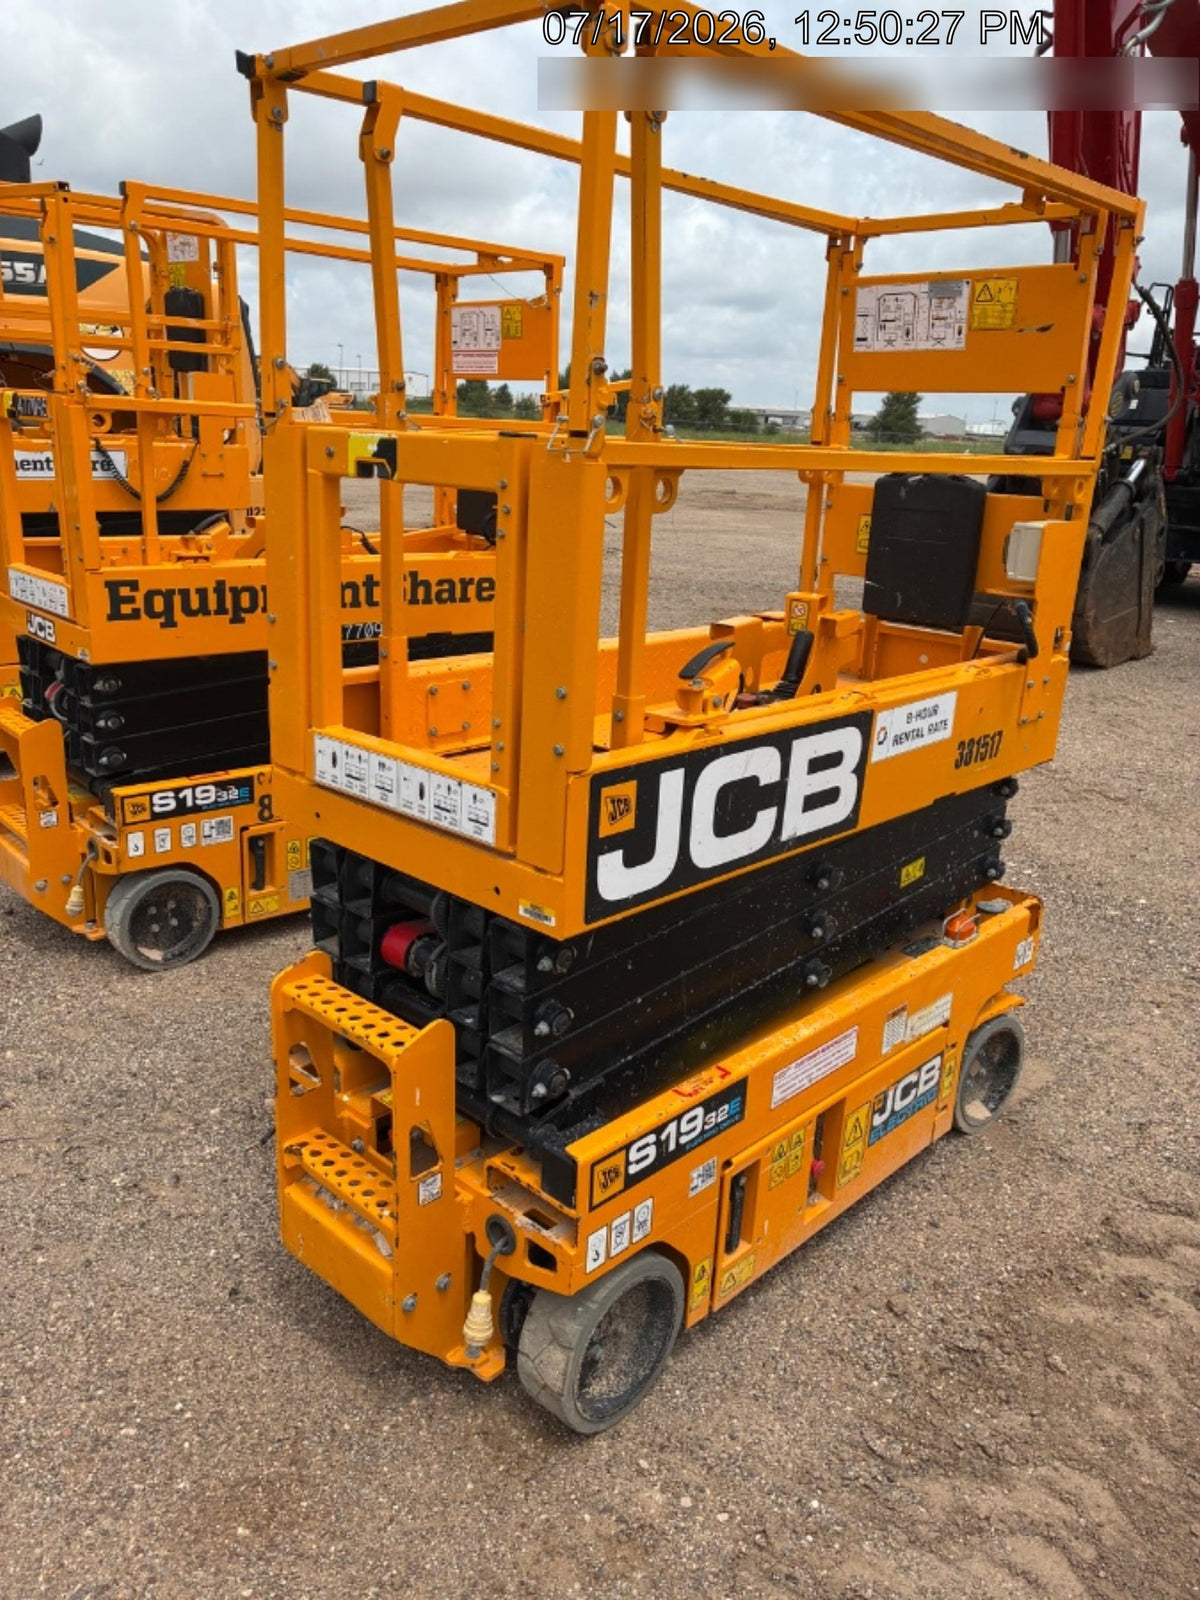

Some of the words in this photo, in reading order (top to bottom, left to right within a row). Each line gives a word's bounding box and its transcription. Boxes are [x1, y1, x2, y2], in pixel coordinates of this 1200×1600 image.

[27, 612, 56, 643] JCB
[892, 727, 925, 747] RENTAL
[927, 718, 949, 736] RATE
[954, 729, 1003, 770] 381517
[597, 726, 862, 901] JCB
[606, 795, 632, 824] JCB
[872, 1055, 943, 1127] JCB
